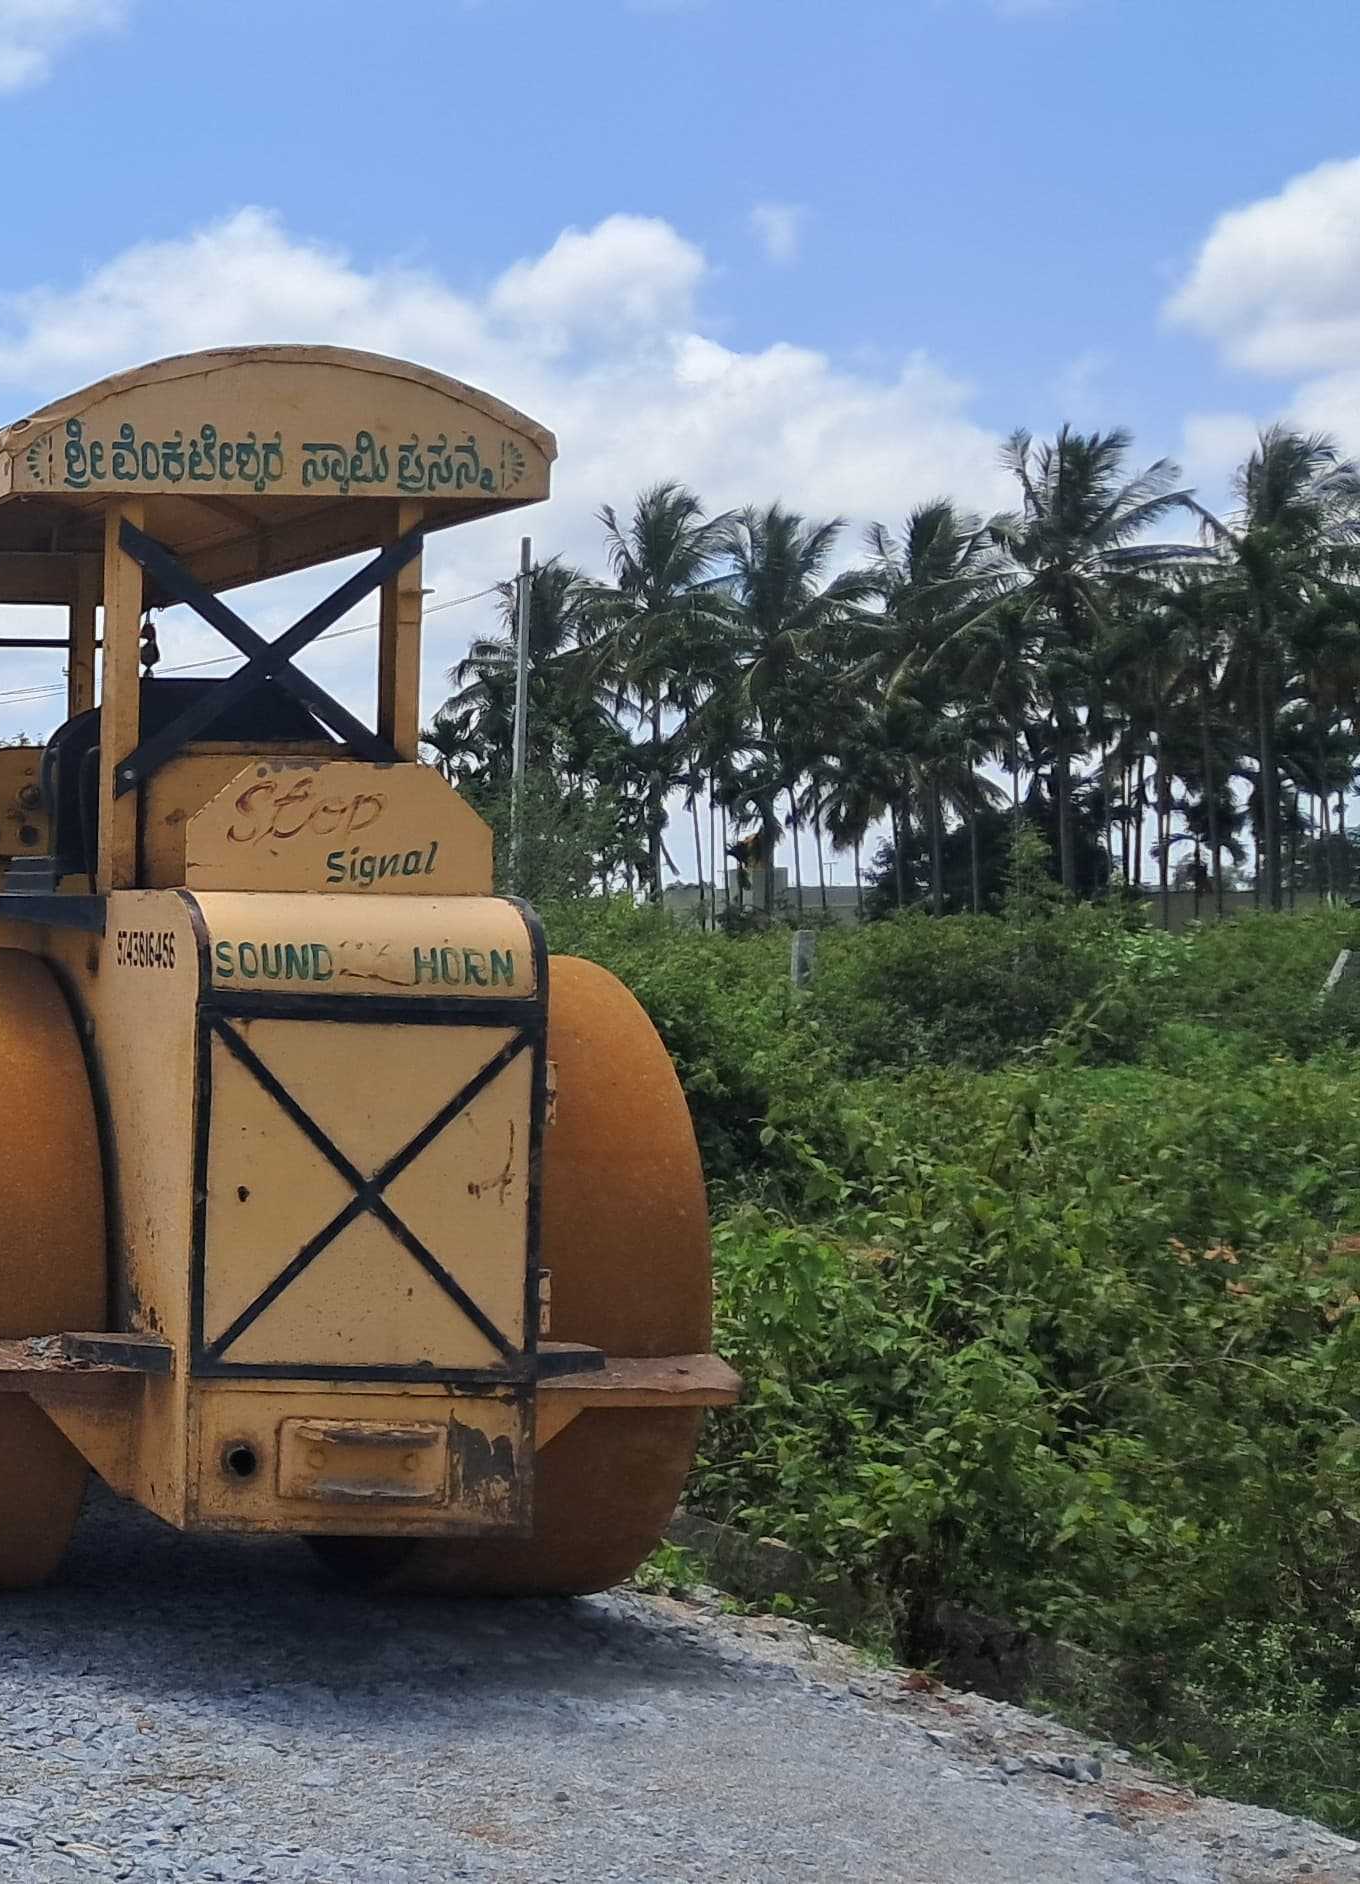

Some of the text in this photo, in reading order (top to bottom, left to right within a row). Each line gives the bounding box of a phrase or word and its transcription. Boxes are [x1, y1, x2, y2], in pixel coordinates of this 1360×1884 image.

[64, 417, 107, 489] ಶ್ರೀ
[302, 430, 390, 494] ಸ್ವಾಮಿ
[397, 432, 498, 494] ಪ್ರಸನ್ನ
[226, 776, 390, 846] Stop
[325, 840, 439, 889] Signal
[215, 940, 516, 987] SOUND HORN
